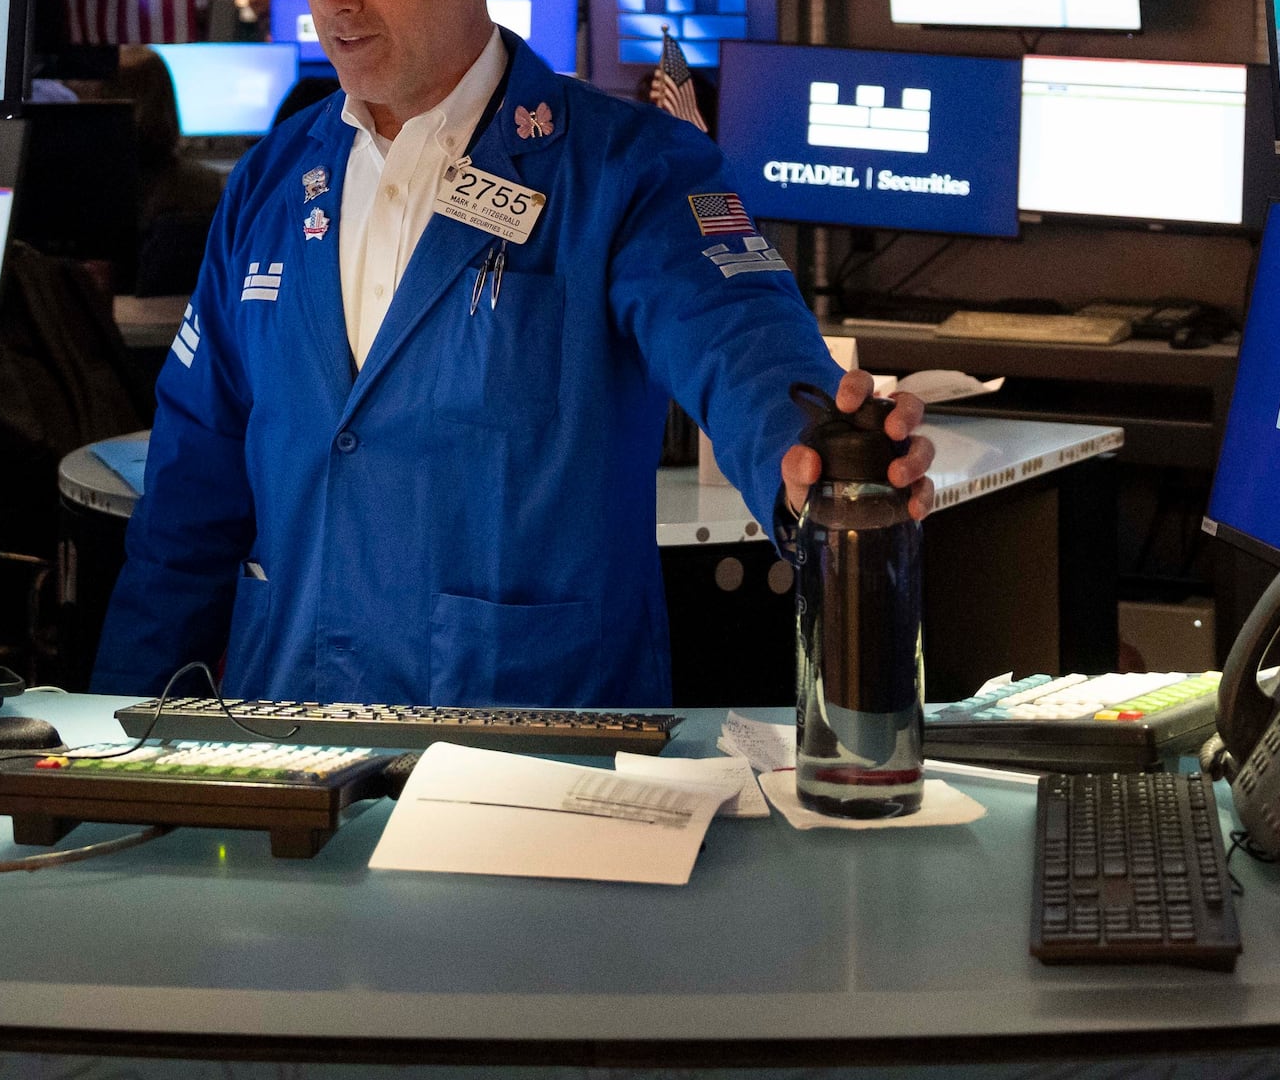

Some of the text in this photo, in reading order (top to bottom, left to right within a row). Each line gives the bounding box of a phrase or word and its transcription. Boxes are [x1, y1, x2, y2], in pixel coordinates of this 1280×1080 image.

[455, 173, 531, 215] 2755
[763, 160, 971, 196] CITADEL Securities
[445, 207, 514, 238] CITADEL SECURITIES LLC
[450, 195, 521, 227] MARK R. FITZGERALD
